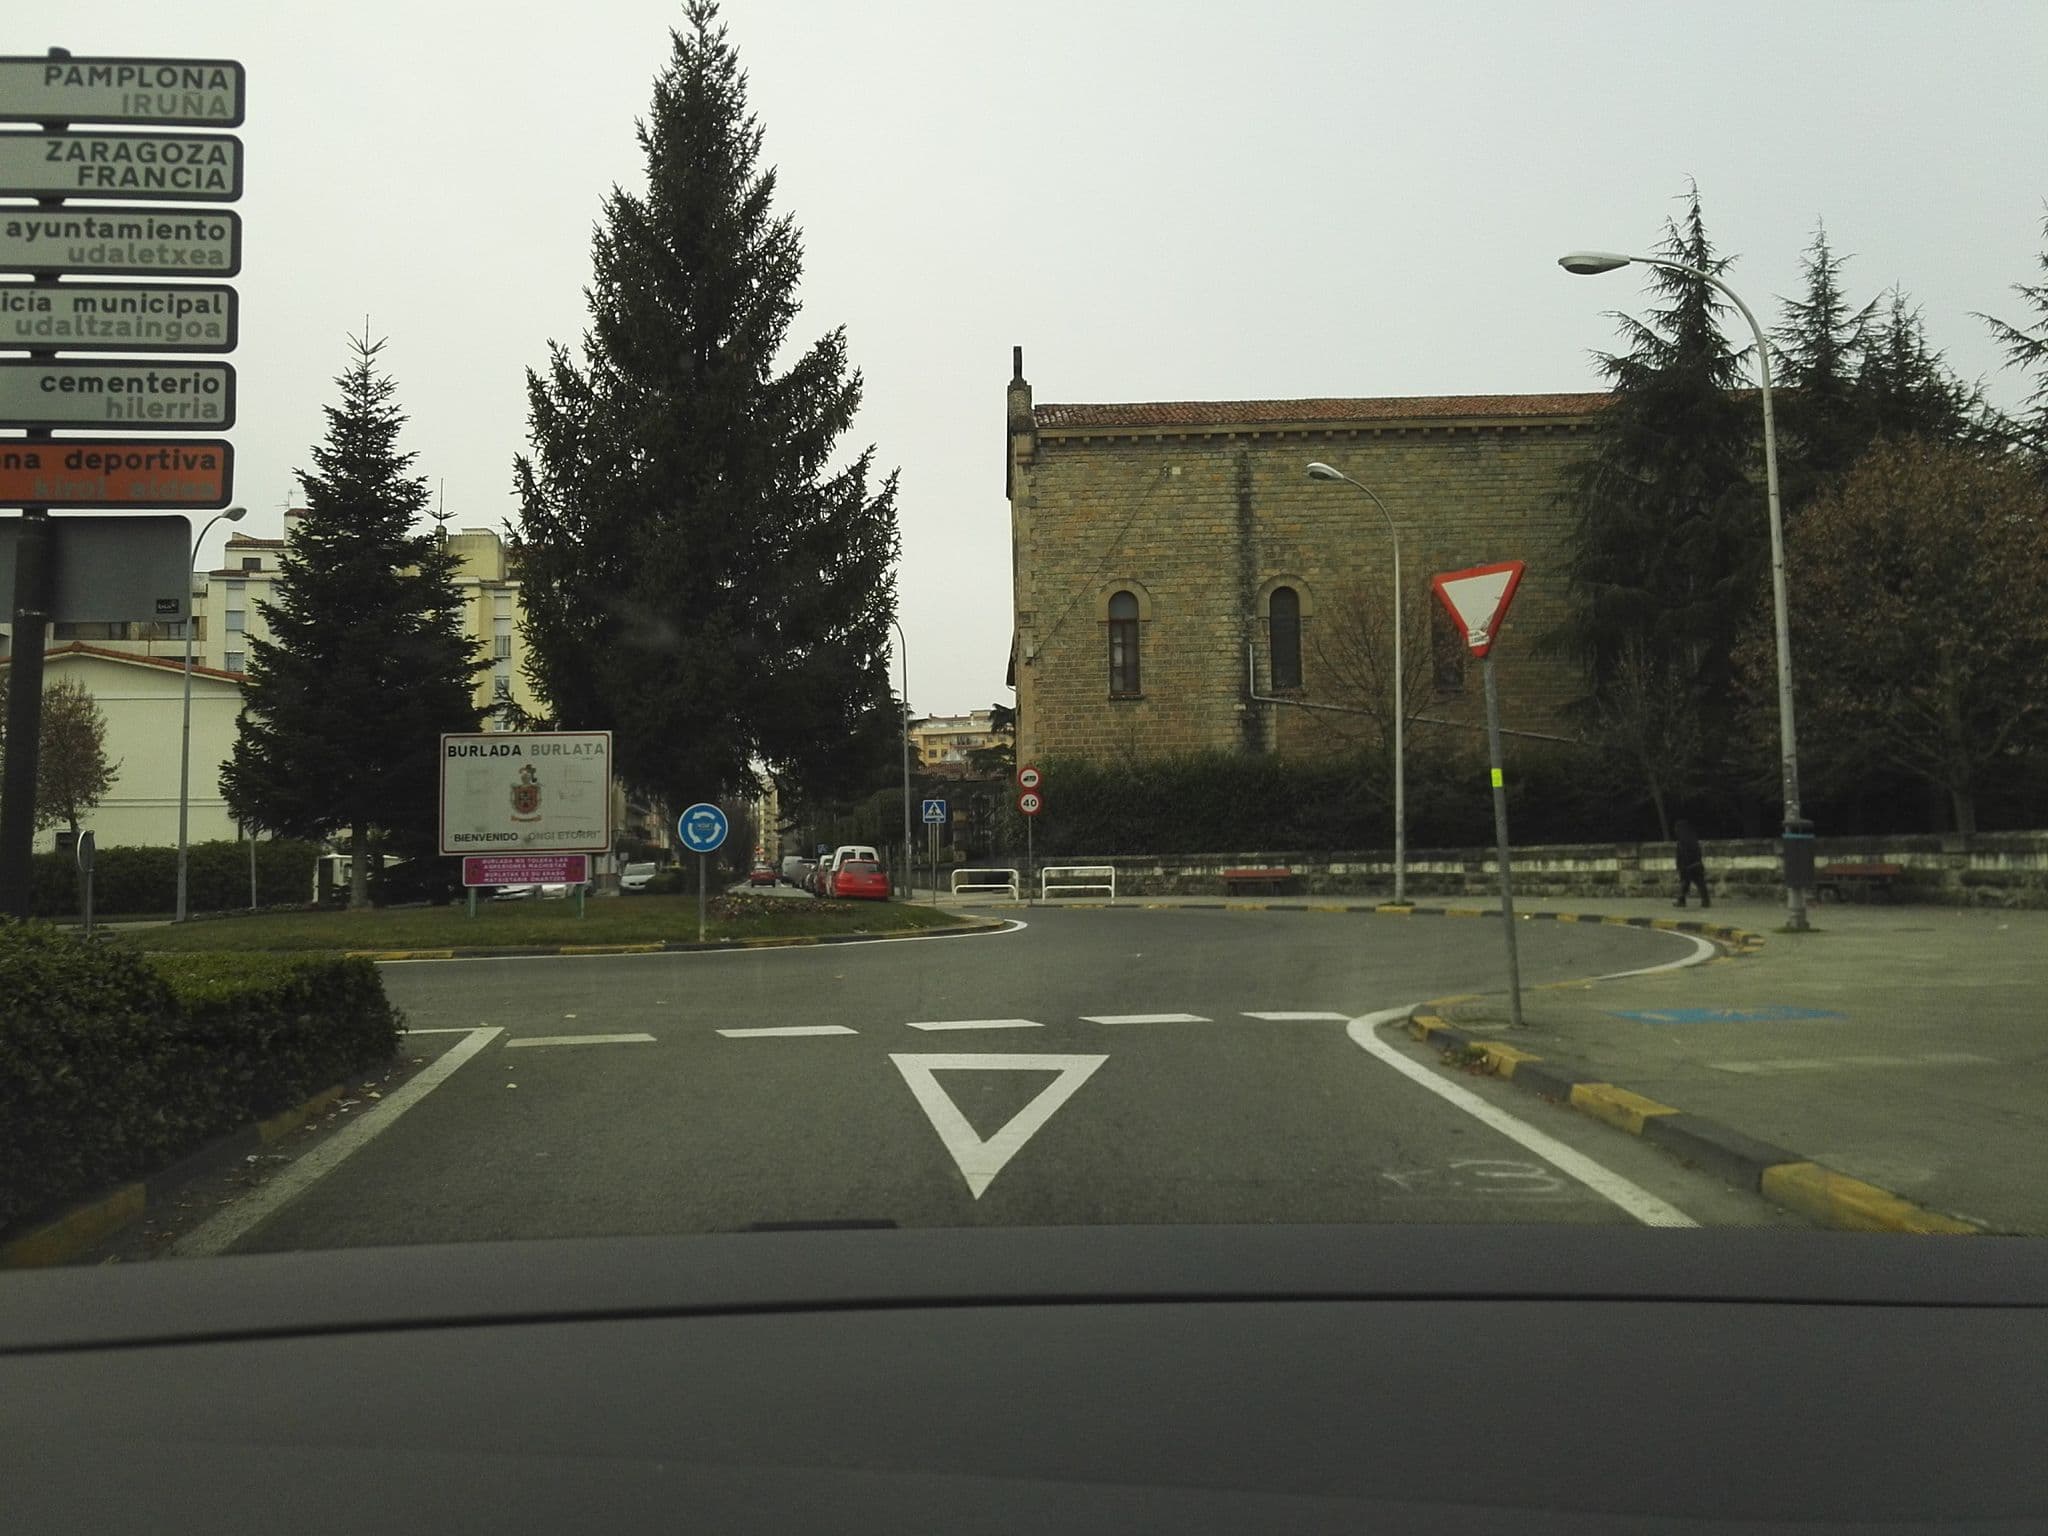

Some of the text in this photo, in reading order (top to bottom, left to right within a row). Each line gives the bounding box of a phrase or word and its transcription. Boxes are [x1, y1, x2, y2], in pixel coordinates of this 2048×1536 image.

[44, 65, 228, 90] PAMPLONA
[121, 91, 228, 116] IRUÑA
[45, 140, 227, 166] ZARAGOZA
[77, 165, 226, 190] FRANCIA
[6, 217, 226, 242] ayuntamiento
[68, 243, 224, 266] udaletxea
[73, 293, 222, 319] municipal
[15, 315, 221, 341] udaltzaingoa
[40, 372, 220, 394] cementerio
[105, 396, 218, 419] hilerria
[64, 449, 216, 475] deportiva
[448, 743, 605, 757] BURLADA BURLATA
[1023, 799, 1037, 807] 40
[454, 833, 518, 842] BIENVENIDO
